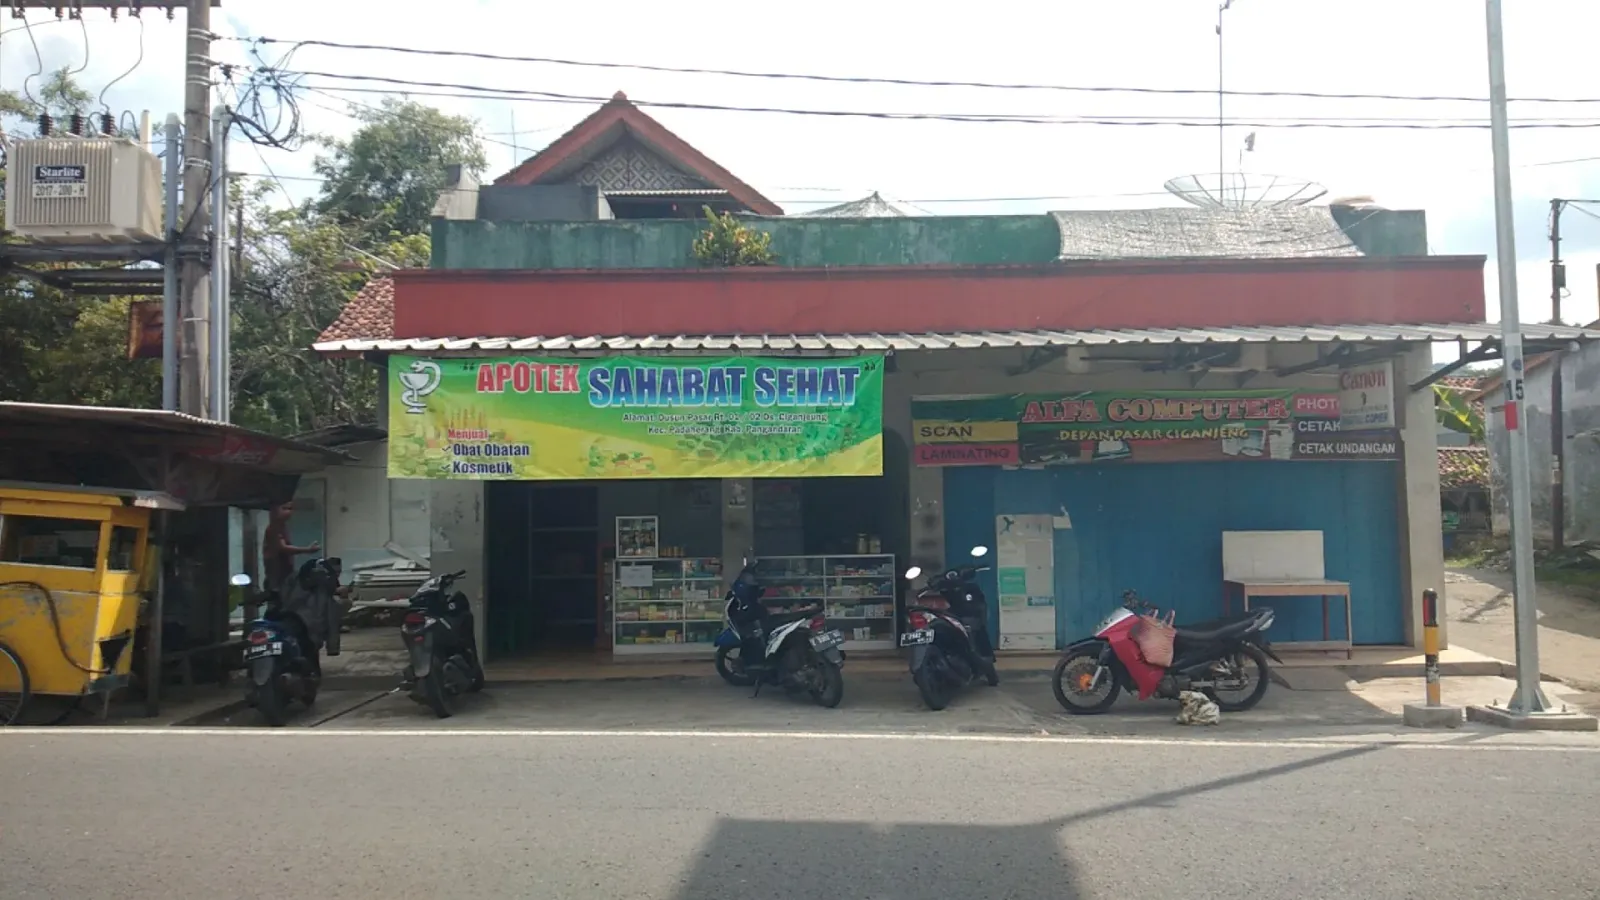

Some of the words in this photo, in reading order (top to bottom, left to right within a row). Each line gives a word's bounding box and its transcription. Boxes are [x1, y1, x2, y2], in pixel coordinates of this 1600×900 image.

[40, 167, 80, 176] Starlite
[477, 362, 580, 393] APOTEK
[588, 366, 746, 407] SAHABAT
[753, 366, 860, 406] SEHAT
[1340, 370, 1387, 391] Canon
[1507, 379, 1524, 400] 15
[1022, 401, 1101, 422] ALFA
[1108, 398, 1290, 420] COMPUTER
[1297, 398, 1340, 410] PHOT
[920, 425, 973, 437] SCAN
[1298, 420, 1341, 432] CETAK
[448, 429, 488, 440] Menjual
[1060, 430, 1110, 440] DEPAN
[1113, 430, 1163, 440] PASAR
[1166, 427, 1248, 439] CIGANJENG
[453, 443, 482, 456] Obat
[484, 443, 530, 456] Obatan
[921, 448, 1010, 460] LAMINATING
[1298, 442, 1335, 455] CETAK
[1336, 442, 1396, 454] UNDANGAN
[452, 460, 513, 474] Kosmetik
